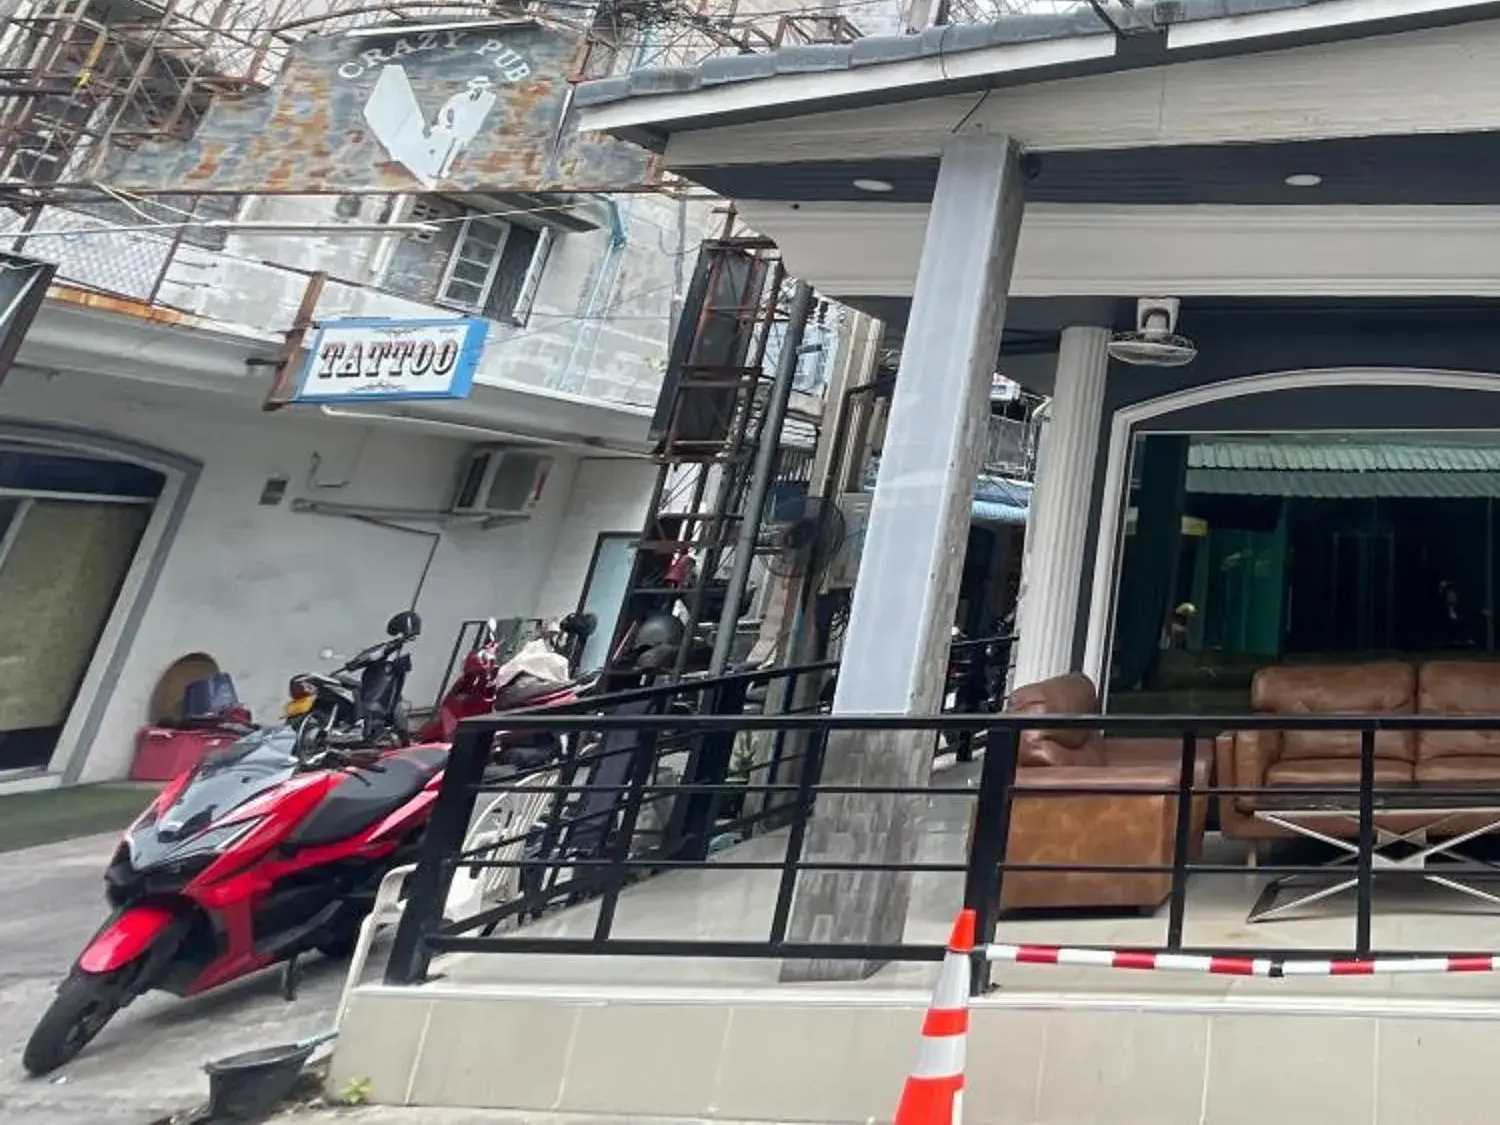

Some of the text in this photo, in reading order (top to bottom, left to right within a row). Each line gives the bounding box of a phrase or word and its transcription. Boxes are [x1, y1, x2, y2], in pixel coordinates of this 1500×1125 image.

[337, 30, 532, 82] CRAZY PUB
[318, 339, 459, 379] TATTOO
